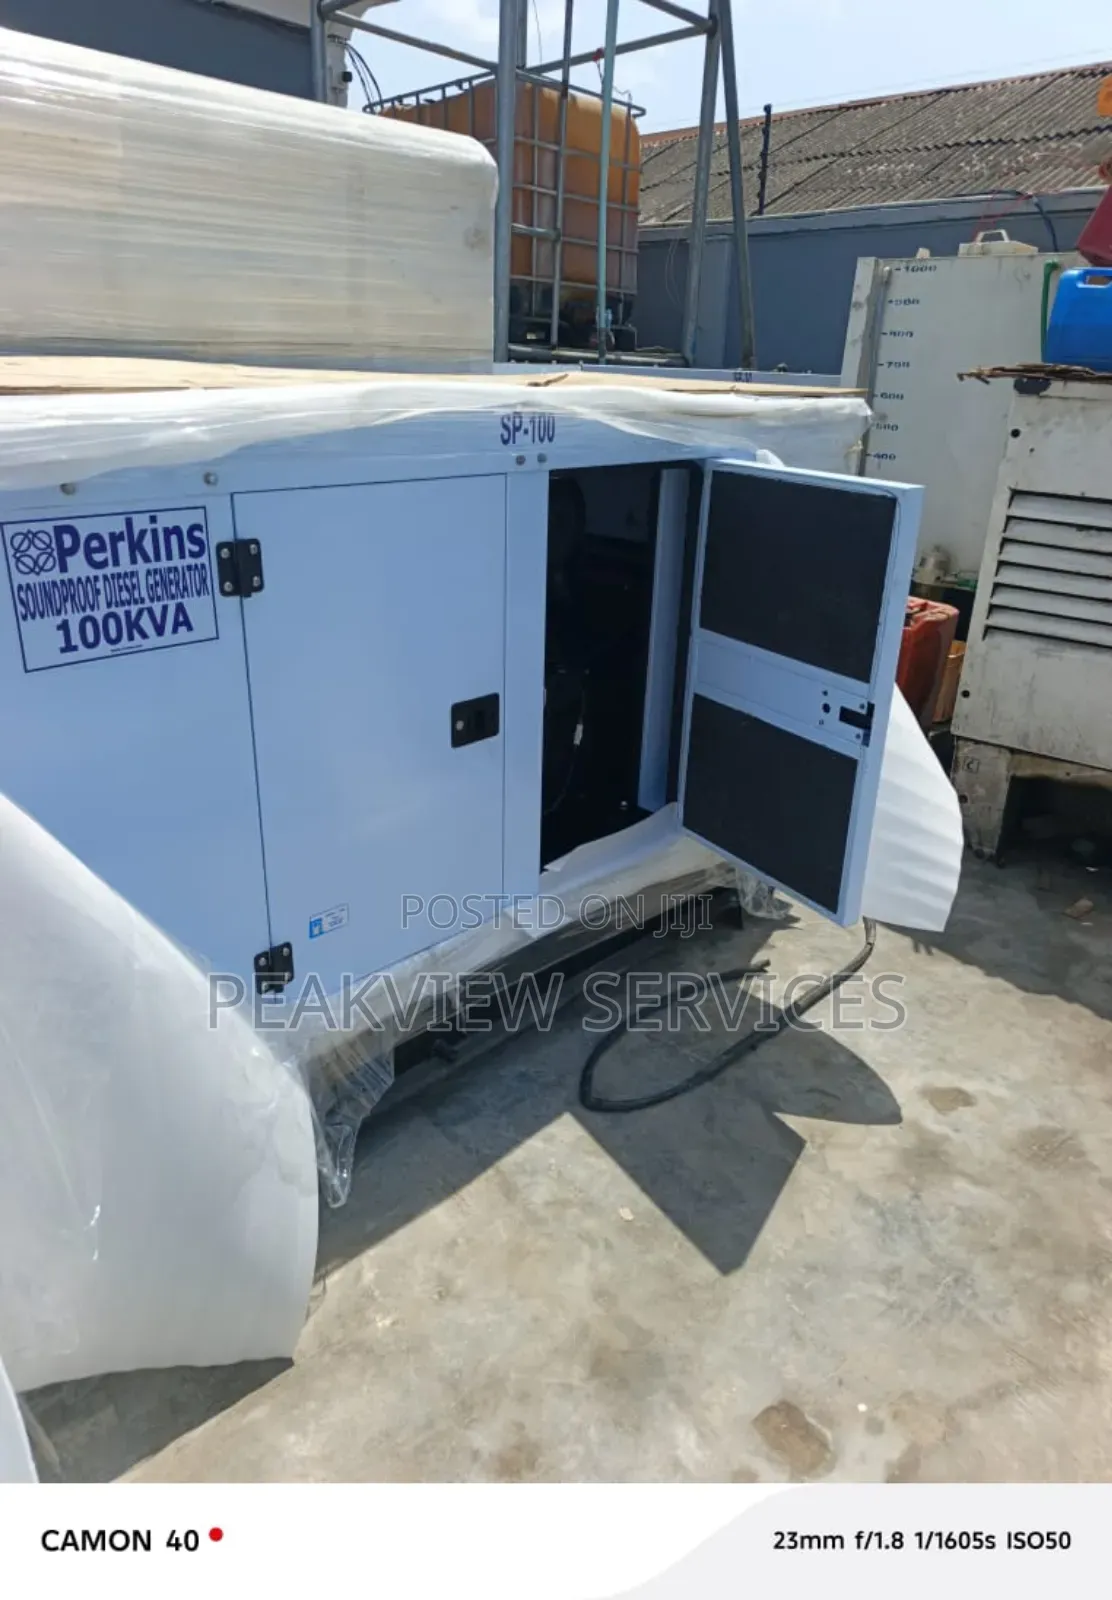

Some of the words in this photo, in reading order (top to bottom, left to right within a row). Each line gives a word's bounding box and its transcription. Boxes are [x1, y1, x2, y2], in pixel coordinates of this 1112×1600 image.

[500, 411, 556, 446] SP-100
[53, 515, 207, 573] Perkins
[17, 575, 102, 622] SOUNDPROOF
[103, 570, 145, 609] DIESEL
[145, 563, 210, 604] GENERATOR
[56, 602, 193, 654] 100KVA
